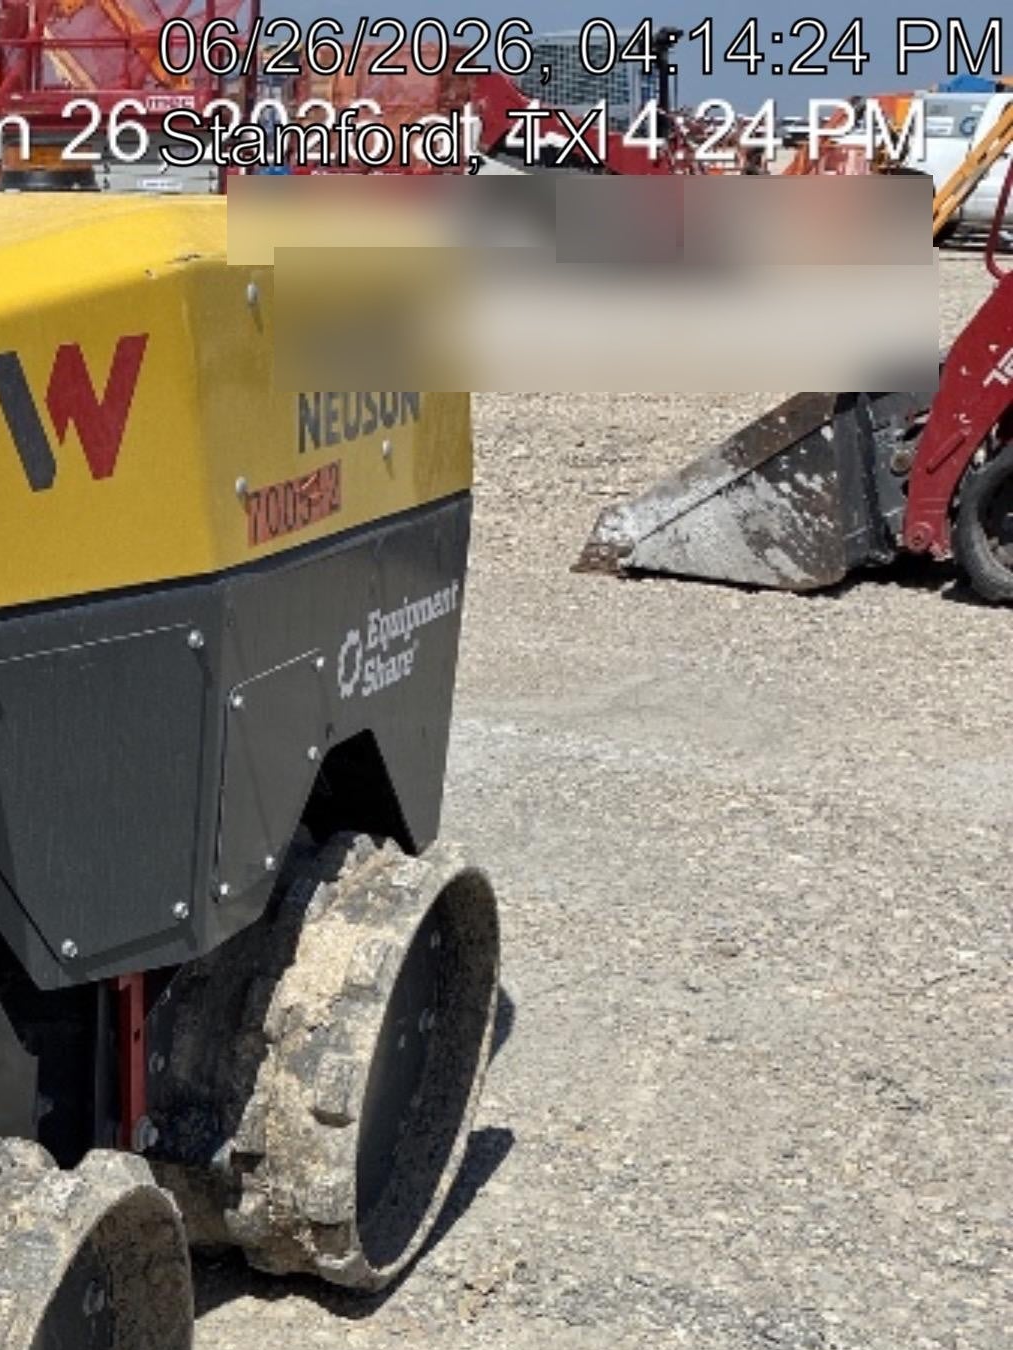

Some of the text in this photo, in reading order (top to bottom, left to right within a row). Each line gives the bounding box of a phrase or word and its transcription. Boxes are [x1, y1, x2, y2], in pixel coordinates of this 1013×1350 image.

[298, 391, 421, 454] NEUSON
[366, 579, 460, 652] Equipment
[361, 646, 417, 698] Share
